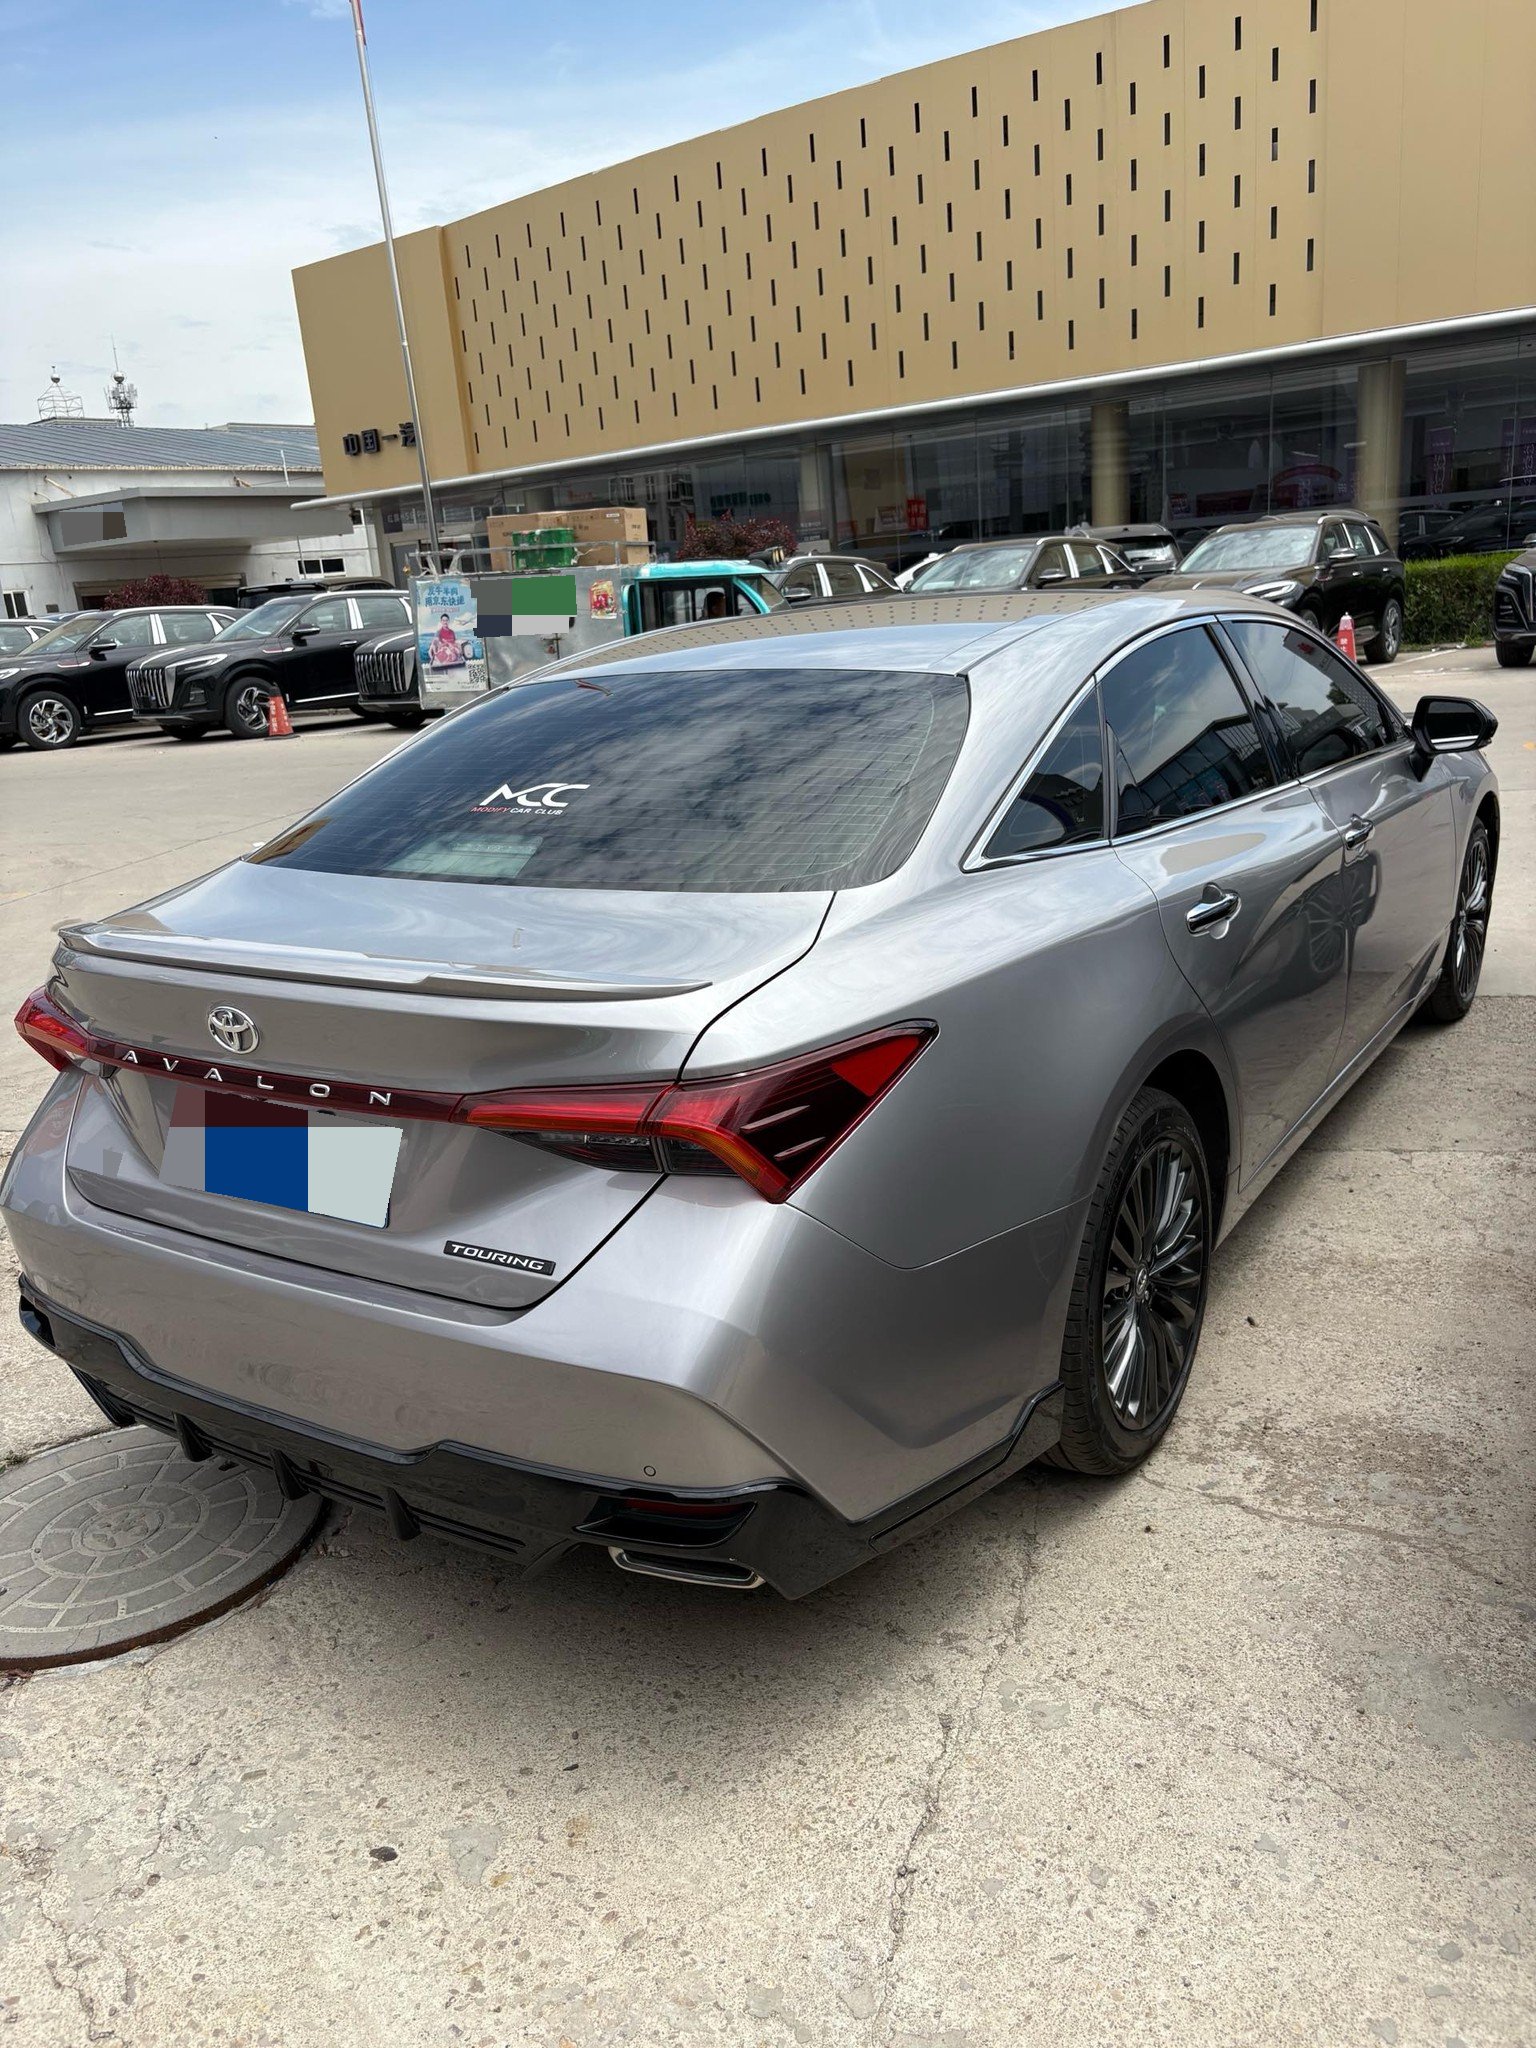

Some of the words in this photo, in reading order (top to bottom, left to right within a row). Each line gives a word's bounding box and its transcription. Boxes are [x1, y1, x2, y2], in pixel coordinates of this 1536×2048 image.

[509, 807, 532, 815] CAR
[534, 808, 563, 816] CLUB
[122, 1050, 392, 1106] AVALON
[452, 1244, 545, 1270] TOURING
